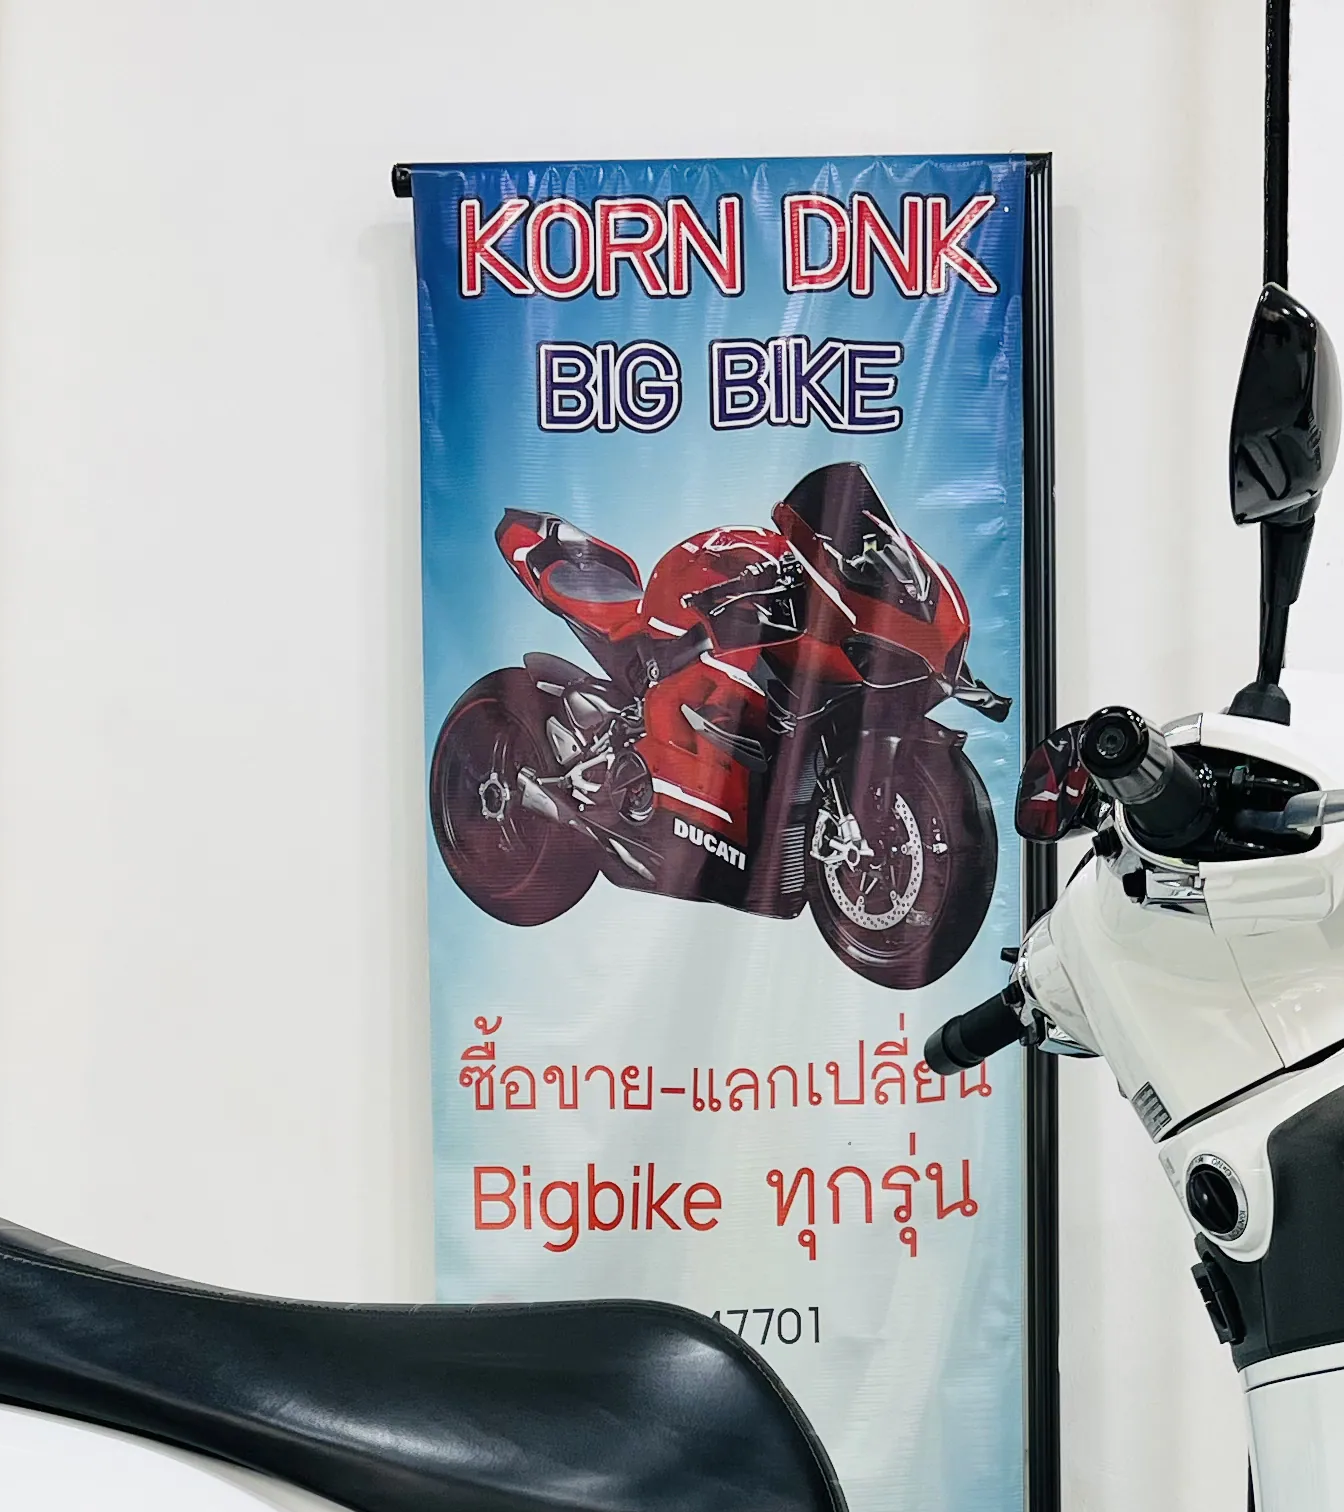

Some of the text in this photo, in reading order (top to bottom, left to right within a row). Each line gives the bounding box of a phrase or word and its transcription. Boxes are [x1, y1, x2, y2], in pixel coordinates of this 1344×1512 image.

[459, 193, 999, 300] KORN DNK
[538, 337, 904, 433] BIG BIKE
[673, 817, 746, 871] DUCATI
[473, 1132, 979, 1262] Bigbike ทุกรุ่น
